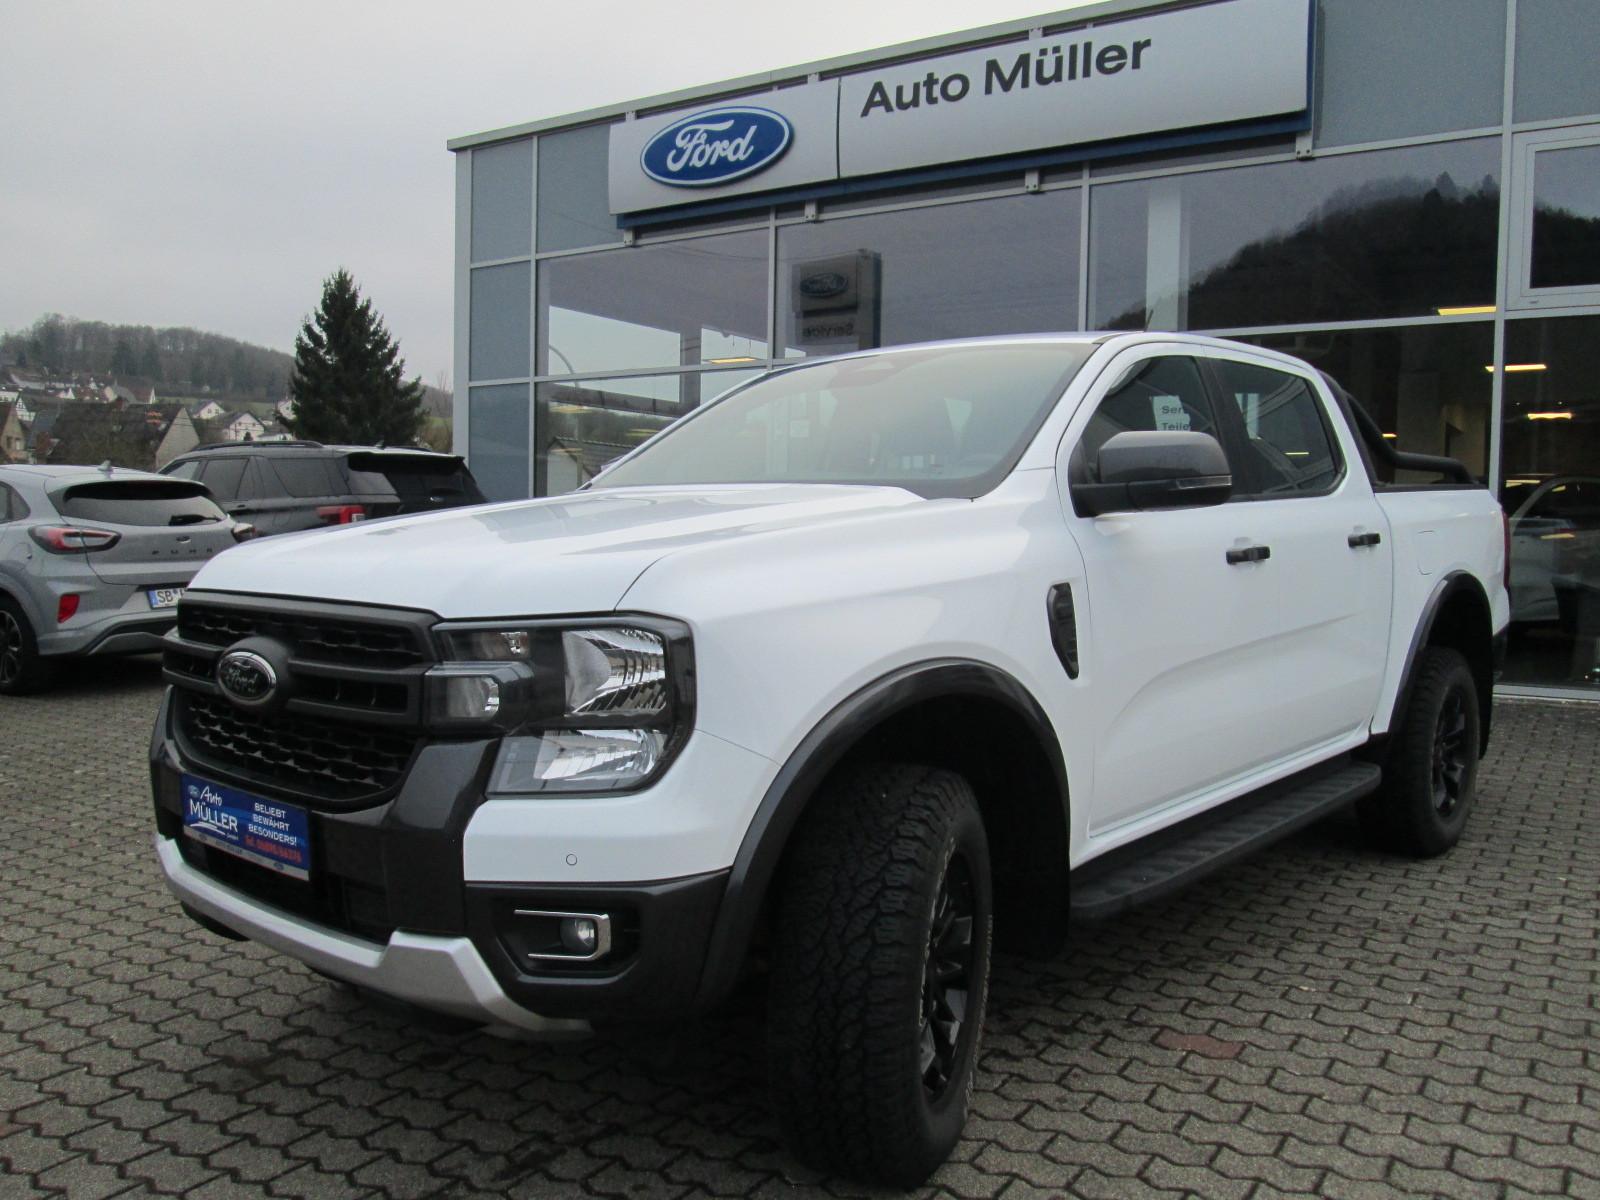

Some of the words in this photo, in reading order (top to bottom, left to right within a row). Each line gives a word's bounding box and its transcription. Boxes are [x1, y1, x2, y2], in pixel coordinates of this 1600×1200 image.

[860, 74, 970, 118] Auto
[983, 38, 1152, 96] Müller
[666, 120, 757, 172] Ford
[200, 785, 222, 806] Auto
[190, 799, 238, 832] MÜLLER
[254, 802, 286, 819] BELIEBT
[252, 813, 290, 831] BEWÄHRT
[248, 824, 297, 846] BESONDERS!
